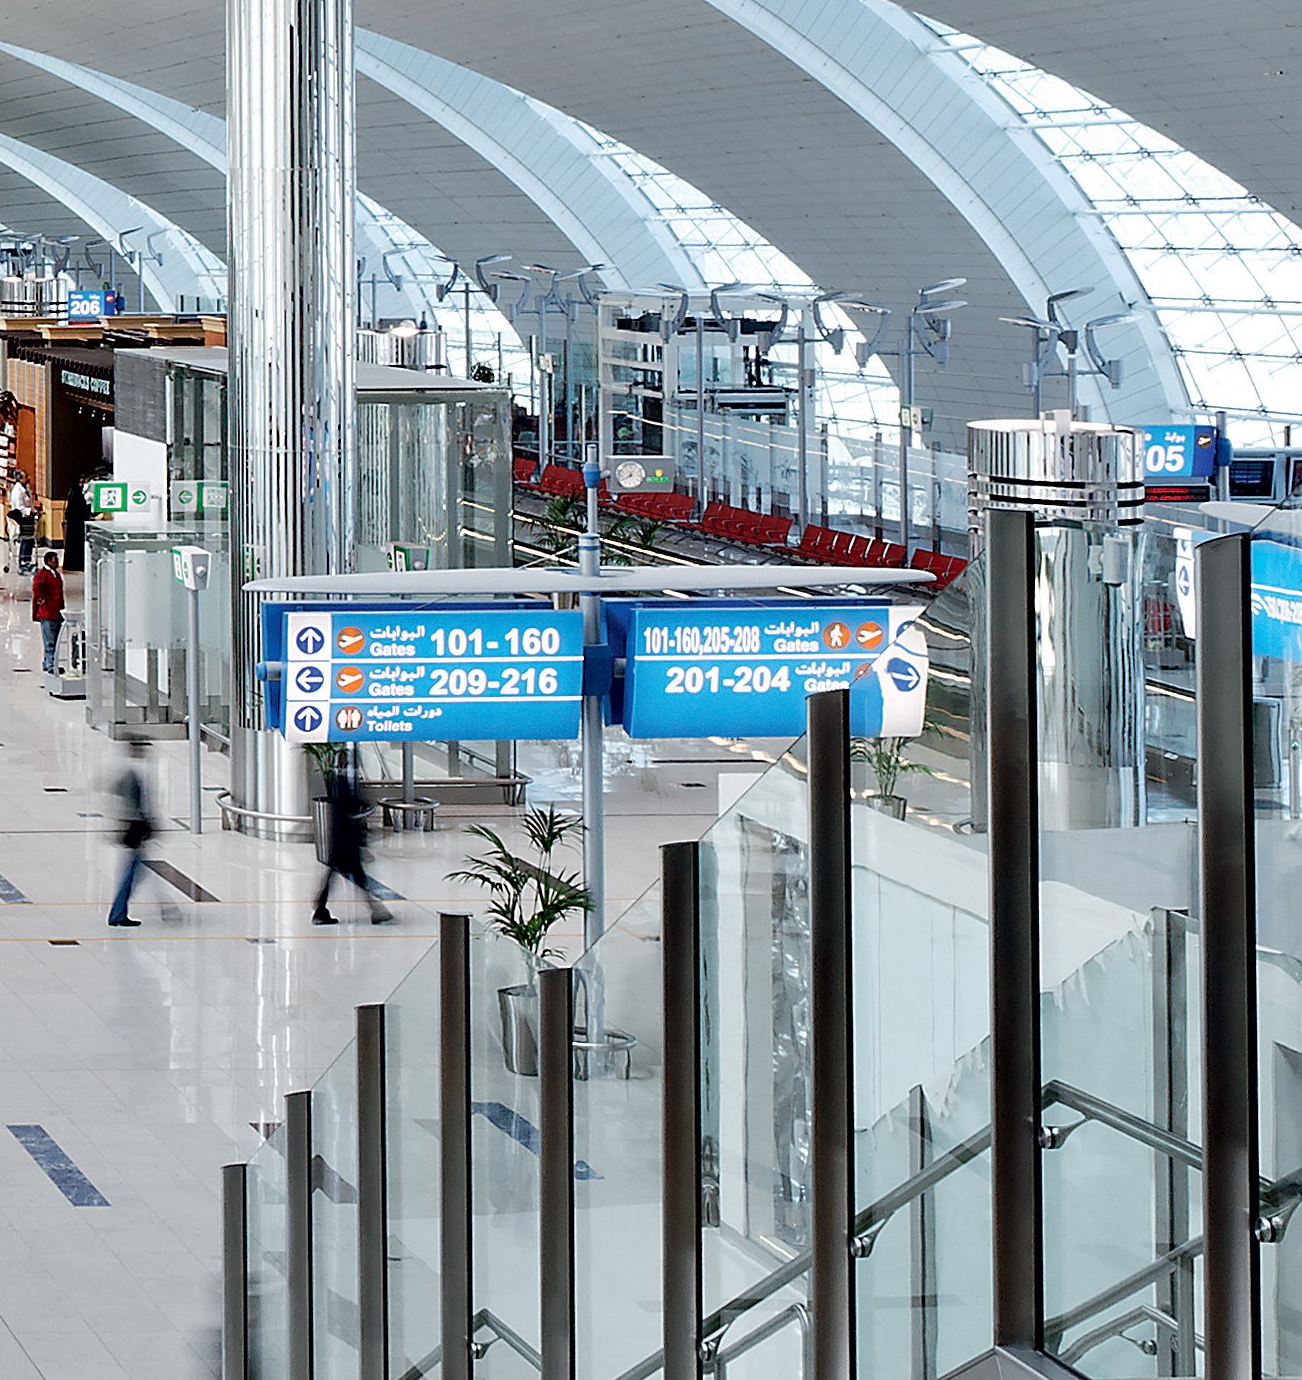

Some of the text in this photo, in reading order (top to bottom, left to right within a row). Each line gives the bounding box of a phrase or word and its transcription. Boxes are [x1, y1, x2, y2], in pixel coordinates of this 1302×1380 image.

[70, 300, 101, 315] 206
[1144, 444, 1185, 473] 05
[369, 625, 426, 642] البوابات
[764, 621, 820, 638] البوابات
[643, 625, 762, 656] 101-160,205-208
[773, 638, 820, 653] Gates
[369, 642, 417, 657] Gates
[368, 665, 426, 682] البوابات
[794, 661, 851, 678] البوابات
[428, 667, 559, 697] 209-216
[664, 665, 792, 694] 201-204
[803, 678, 851, 692] Gates
[368, 682, 415, 697] Gates
[366, 705, 444, 720] دورات المياه
[366, 719, 414, 733] Toilets
